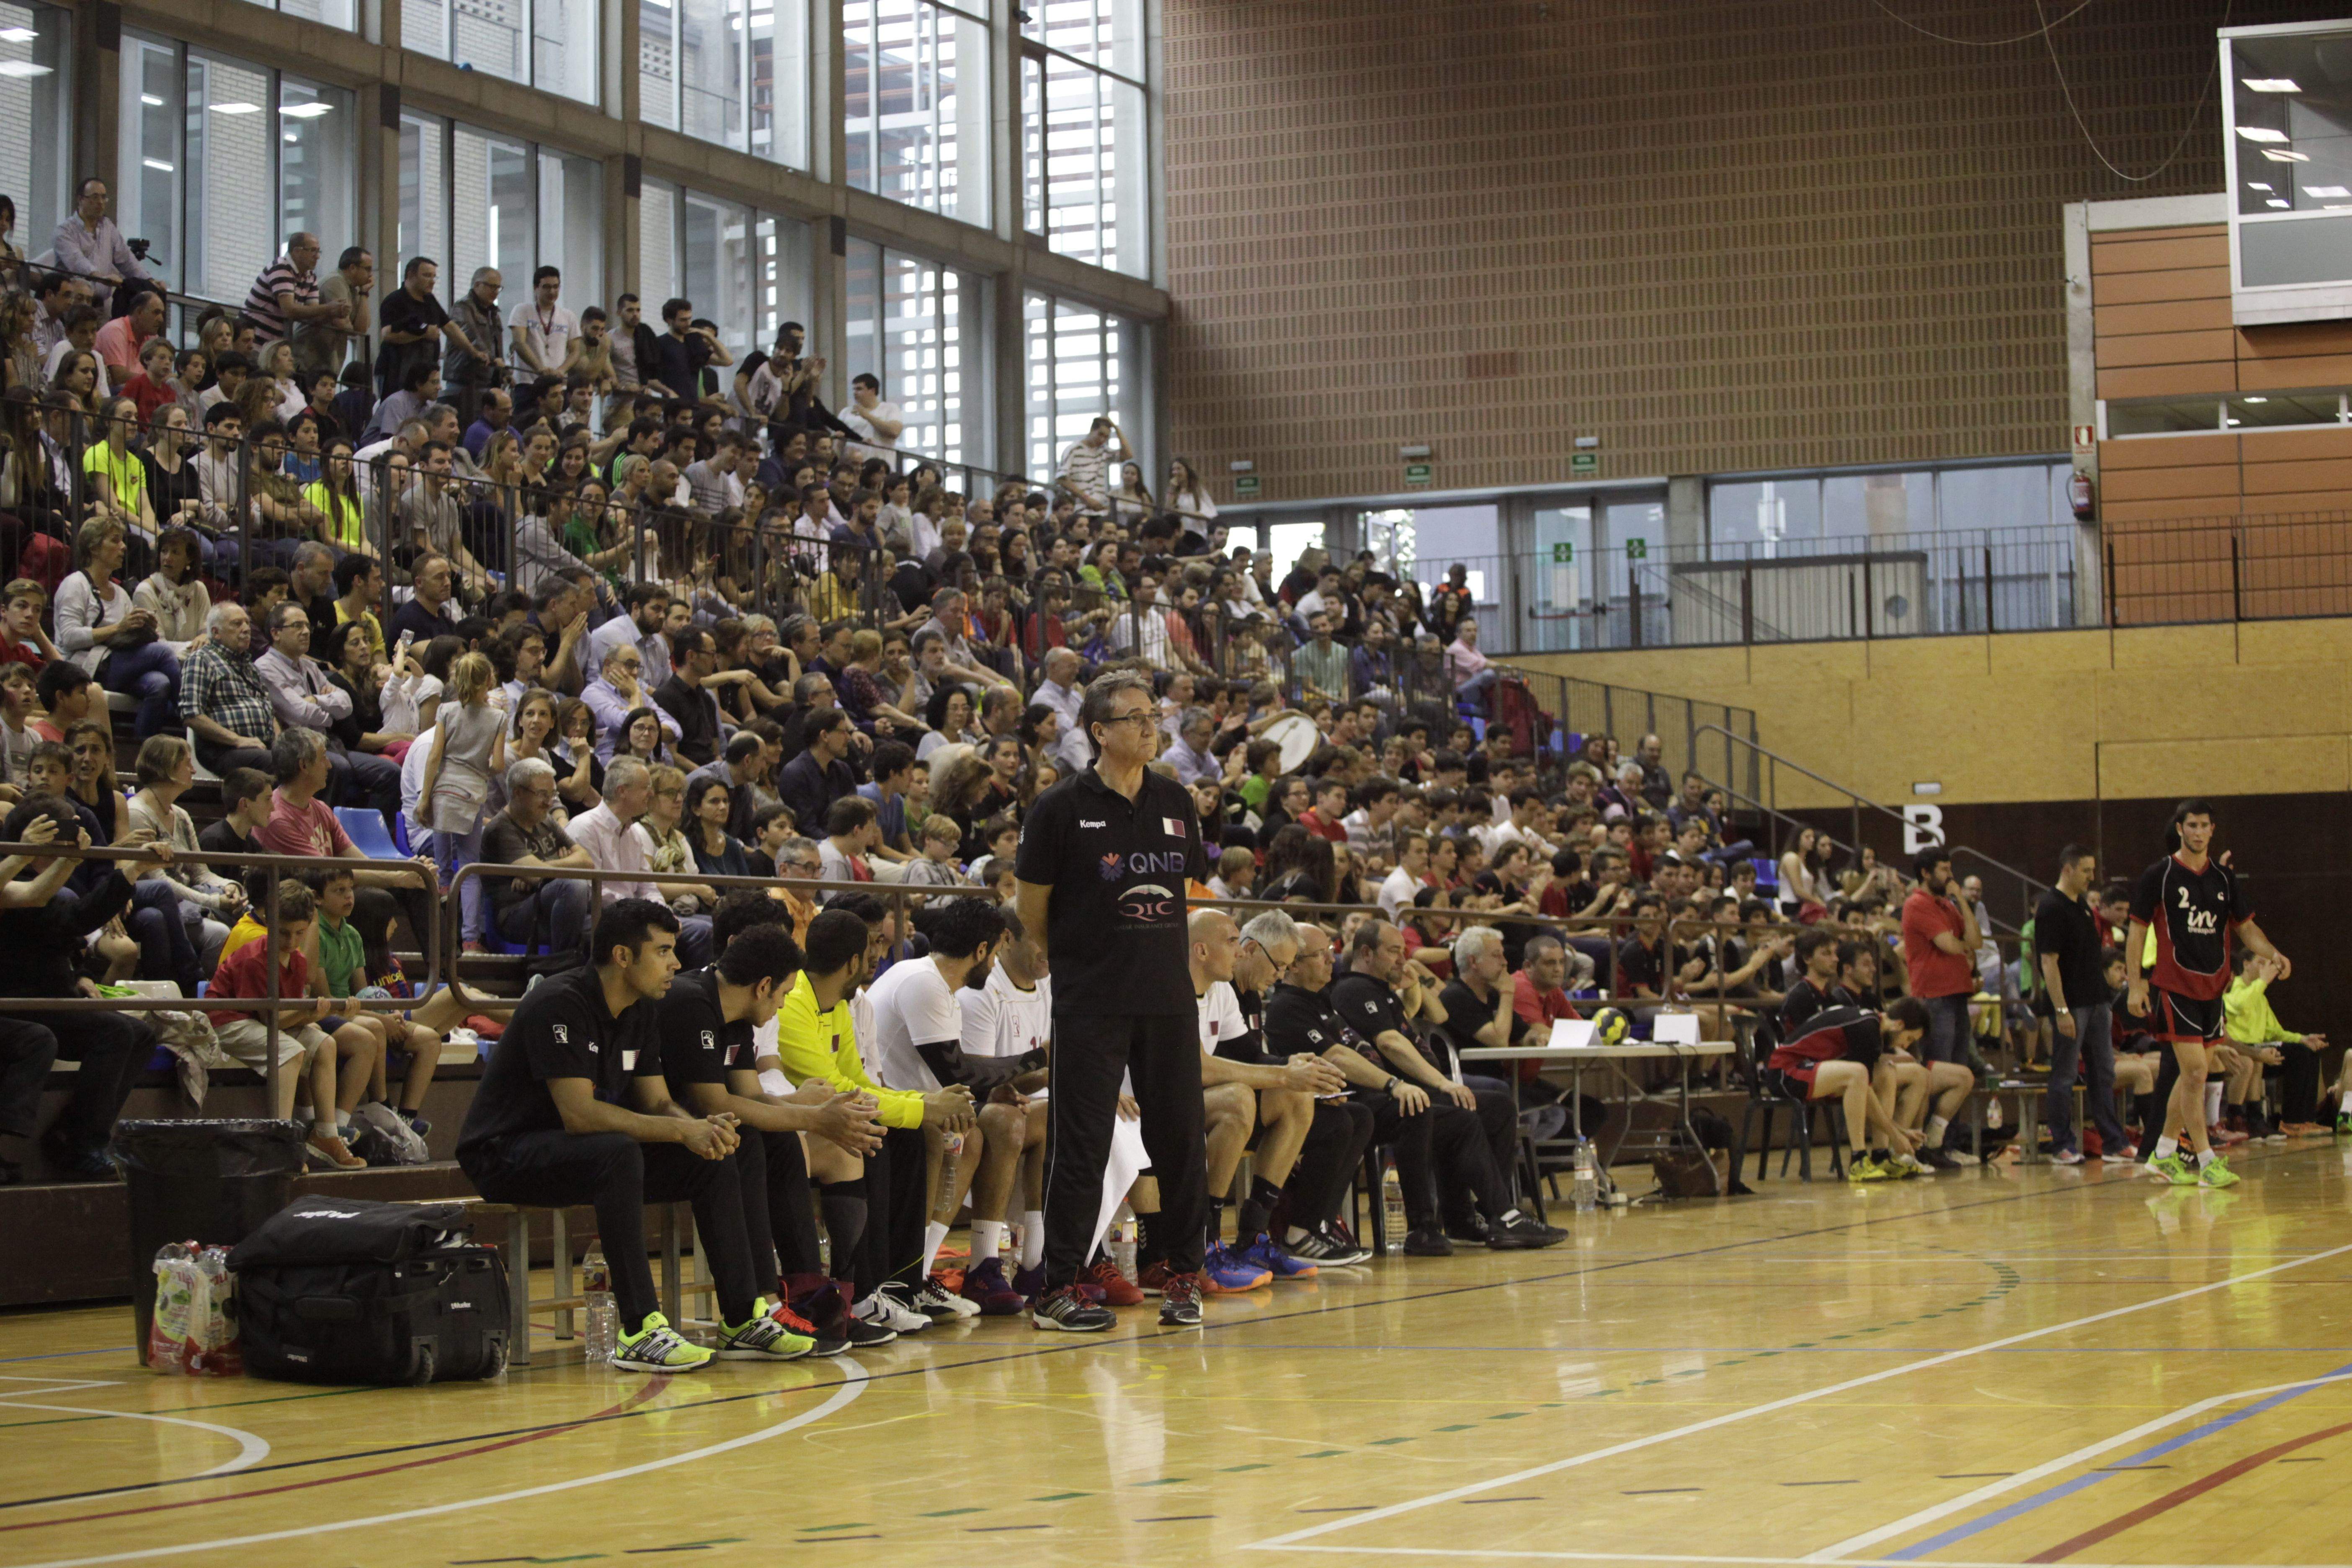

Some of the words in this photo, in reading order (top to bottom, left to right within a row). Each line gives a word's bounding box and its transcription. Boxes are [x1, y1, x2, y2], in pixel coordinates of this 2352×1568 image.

[1080, 819, 1106, 829] Kempa
[1903, 804, 1946, 855] B
[1129, 851, 1184, 874] QNB
[2178, 886, 2190, 908] 2
[1118, 901, 1174, 922] QIC
